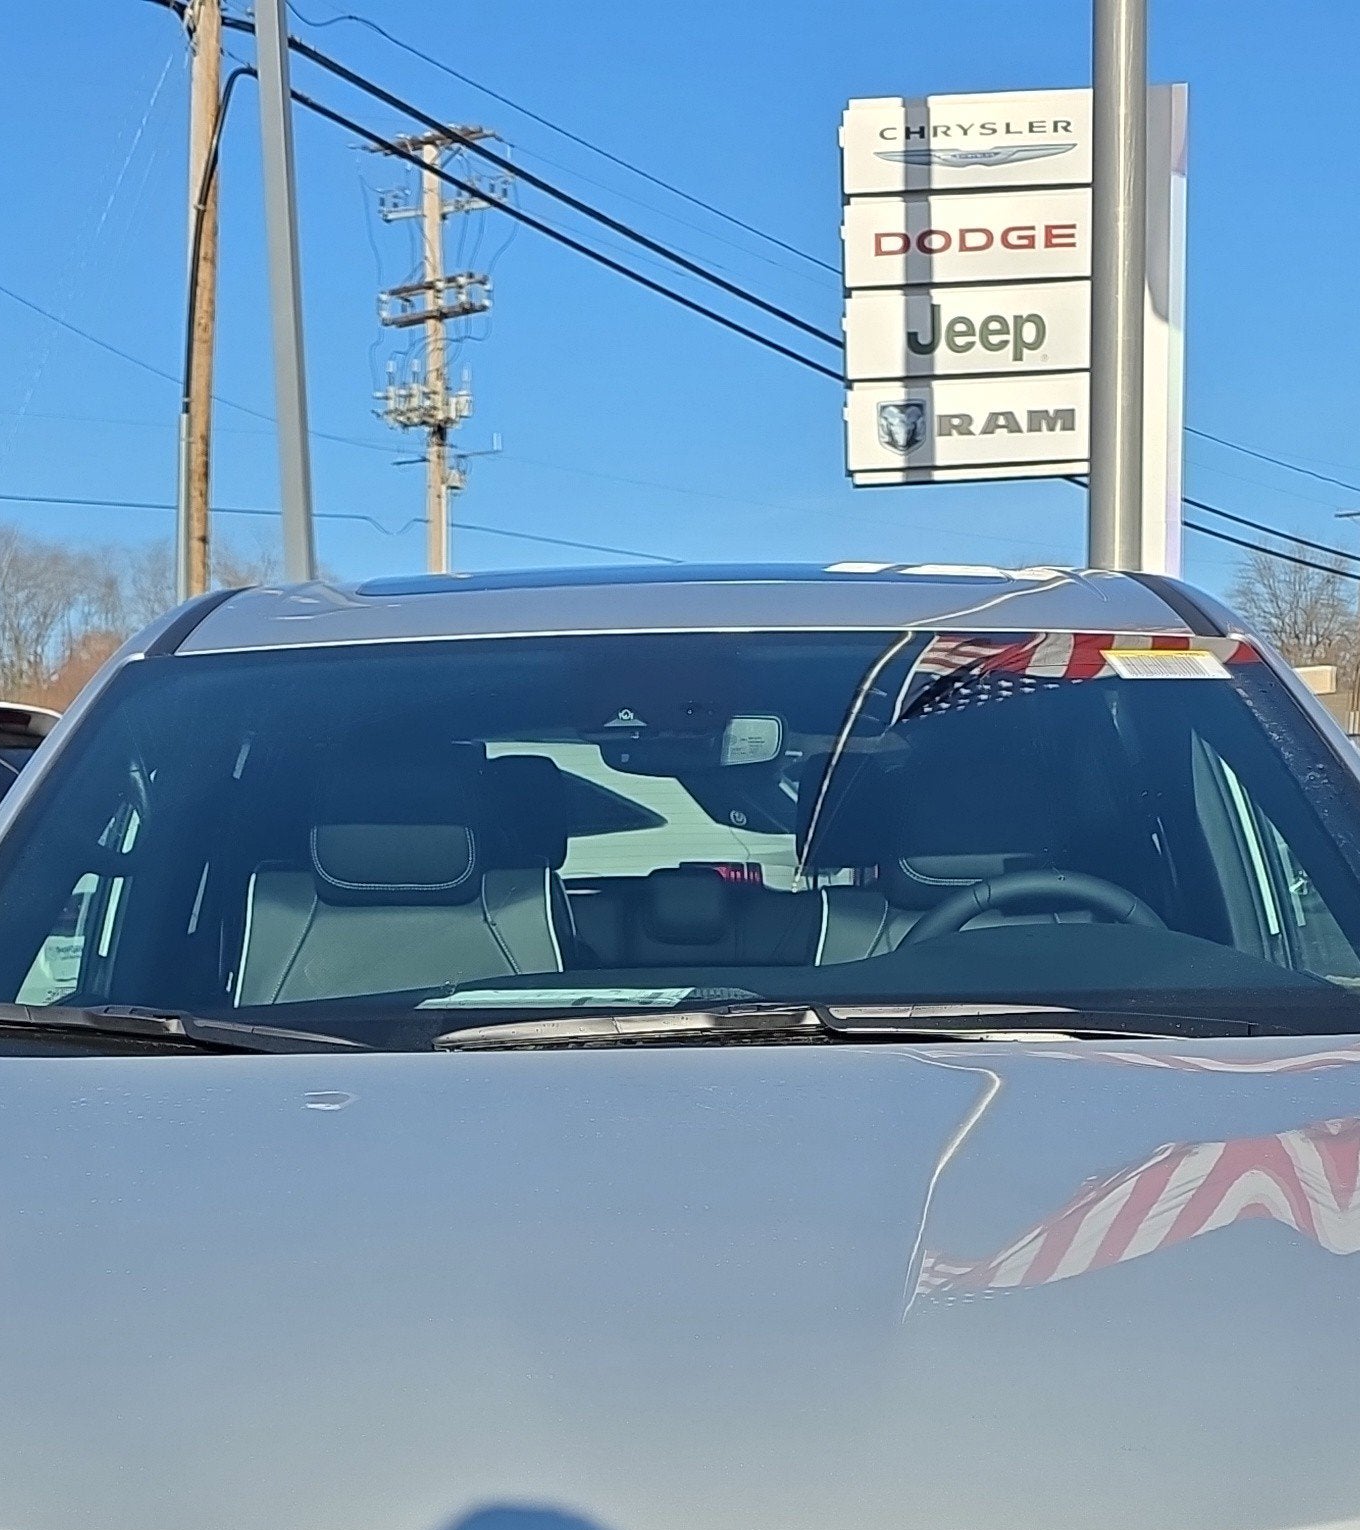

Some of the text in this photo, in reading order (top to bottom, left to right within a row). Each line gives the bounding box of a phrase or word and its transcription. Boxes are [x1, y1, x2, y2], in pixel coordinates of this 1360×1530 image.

[879, 119, 1074, 141] CHRYSLER
[873, 223, 1078, 257] DODGE
[907, 303, 1047, 362] Jeep
[936, 408, 1076, 437] RAM
